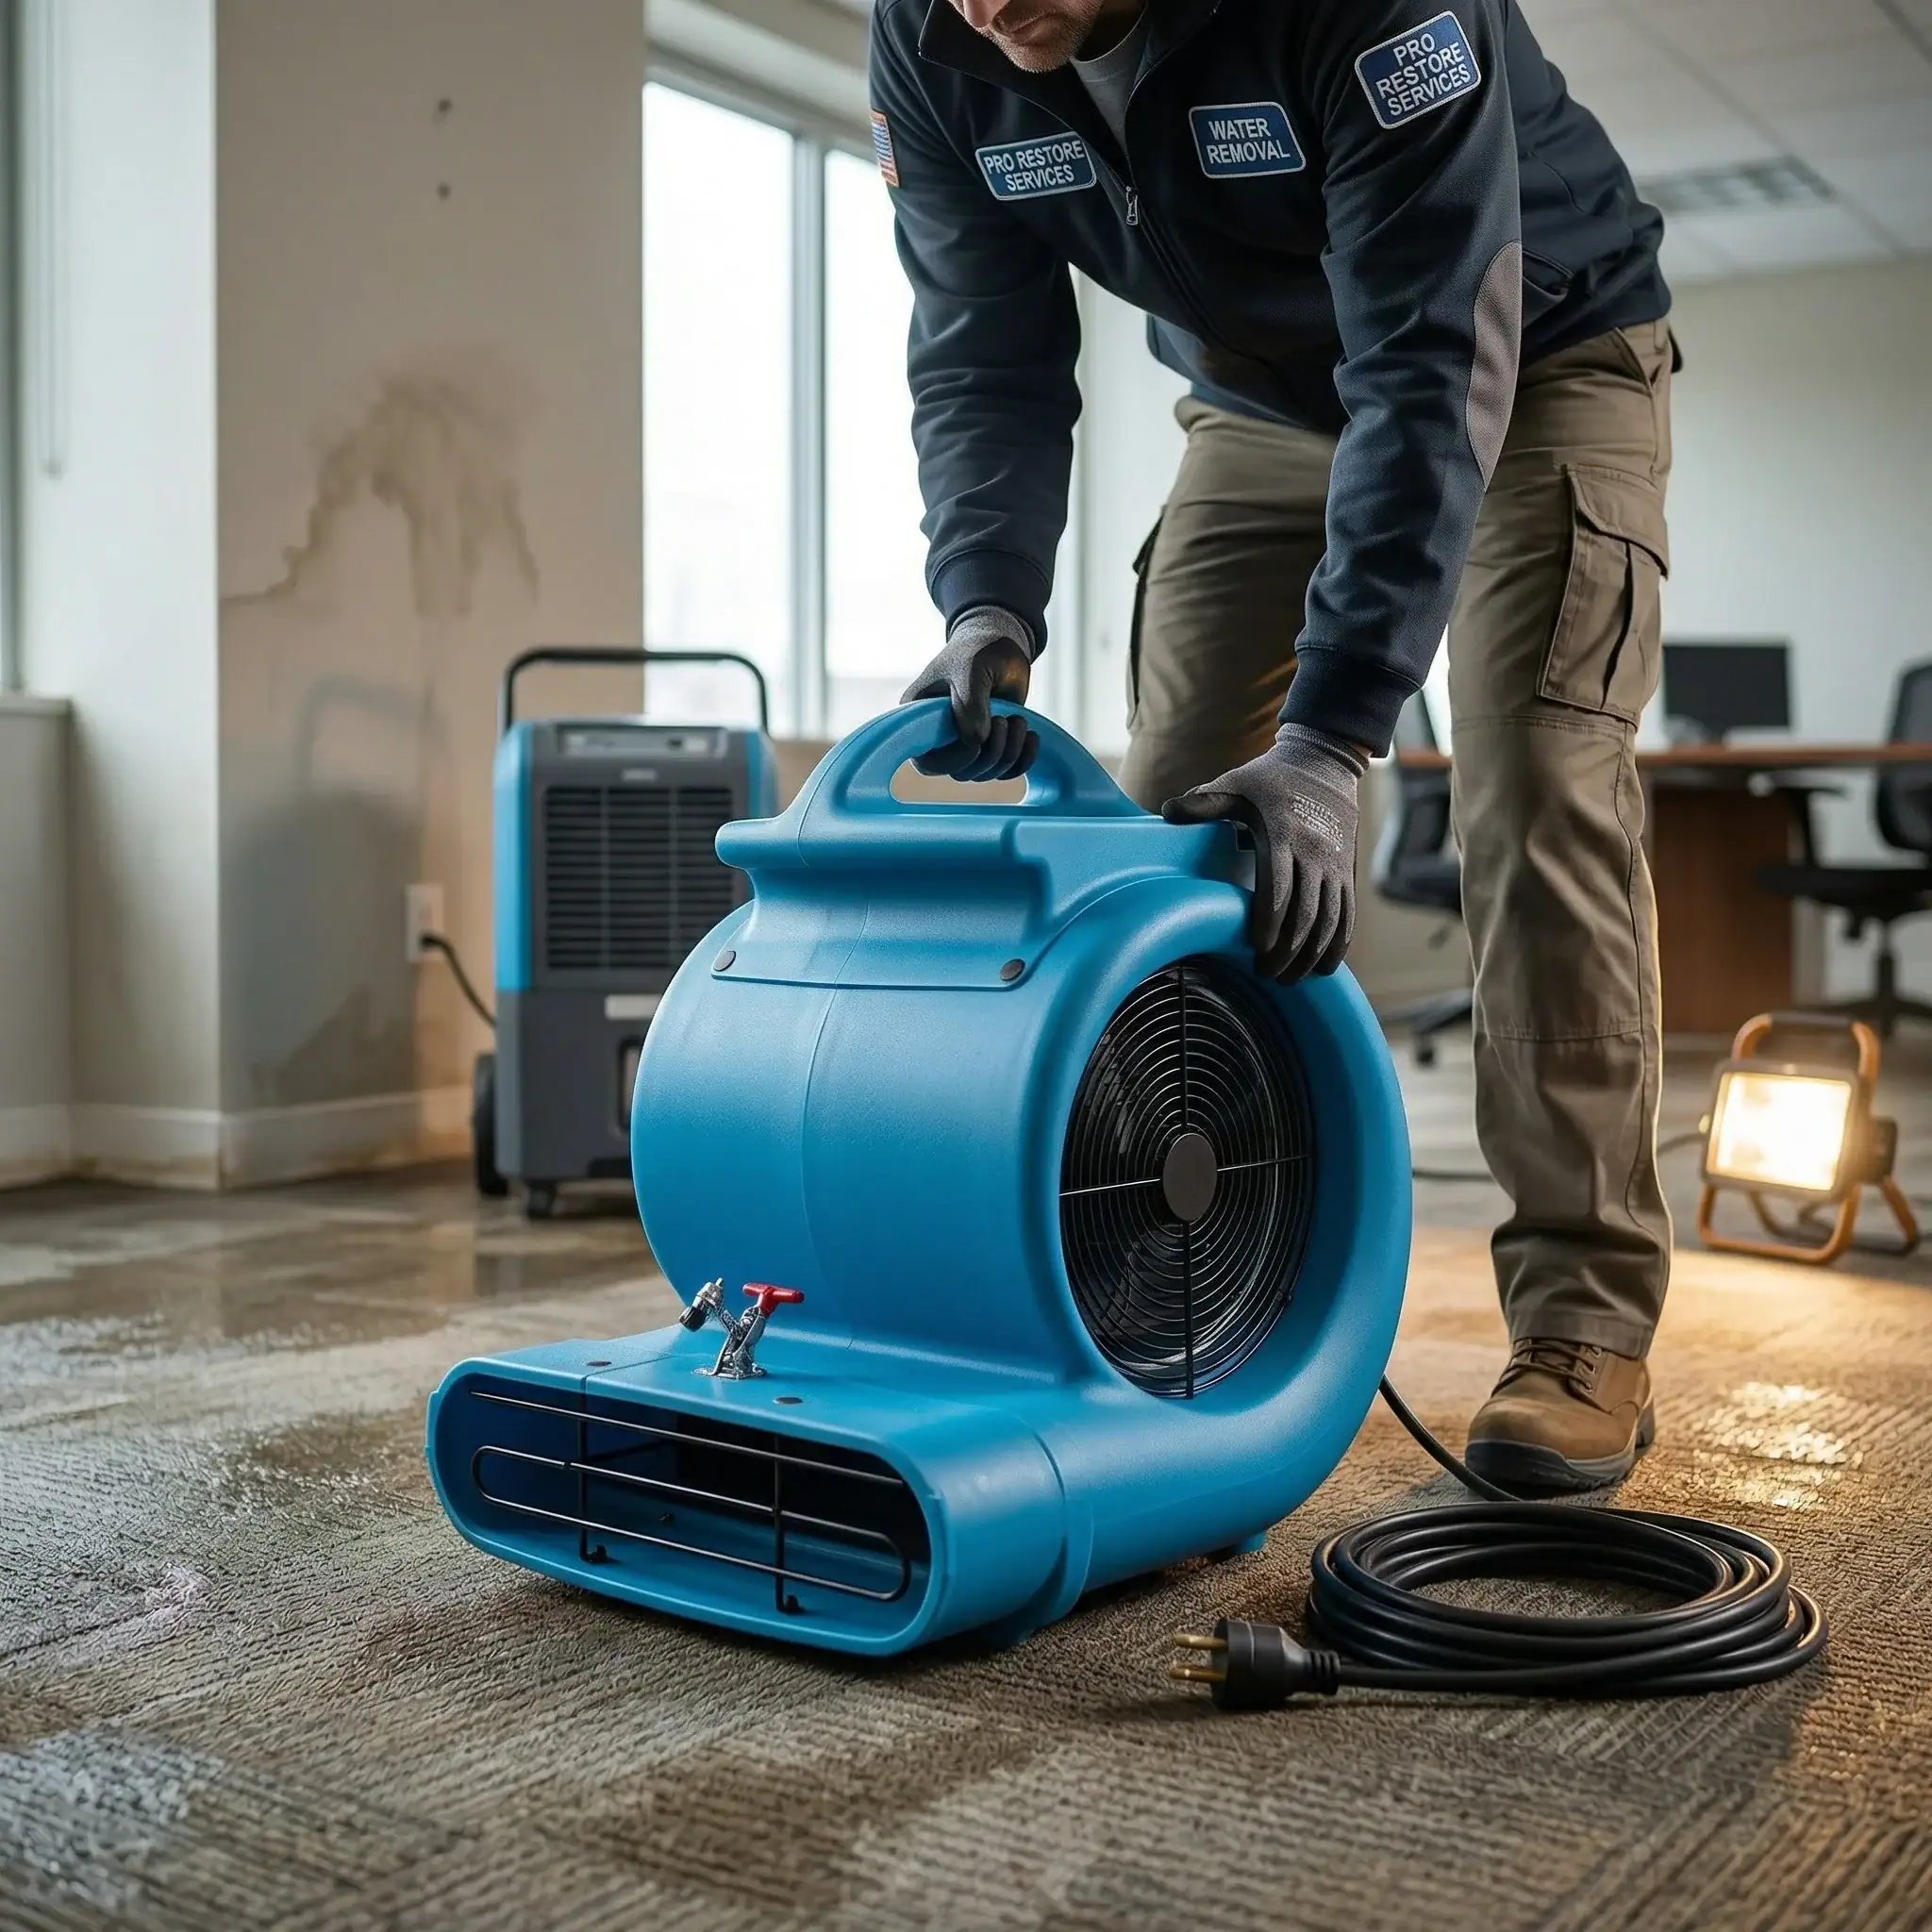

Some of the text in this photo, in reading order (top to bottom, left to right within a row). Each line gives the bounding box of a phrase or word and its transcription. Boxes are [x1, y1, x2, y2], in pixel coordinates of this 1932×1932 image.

[1392, 33, 1435, 66] PRO
[1375, 42, 1465, 99] RESTORE
[1388, 63, 1471, 116] SERVICES
[1208, 118, 1272, 141] WATER
[984, 141, 1085, 175] PRO RESTORE
[1207, 140, 1291, 164] REMOVAL
[1005, 164, 1074, 192] SERVICES
